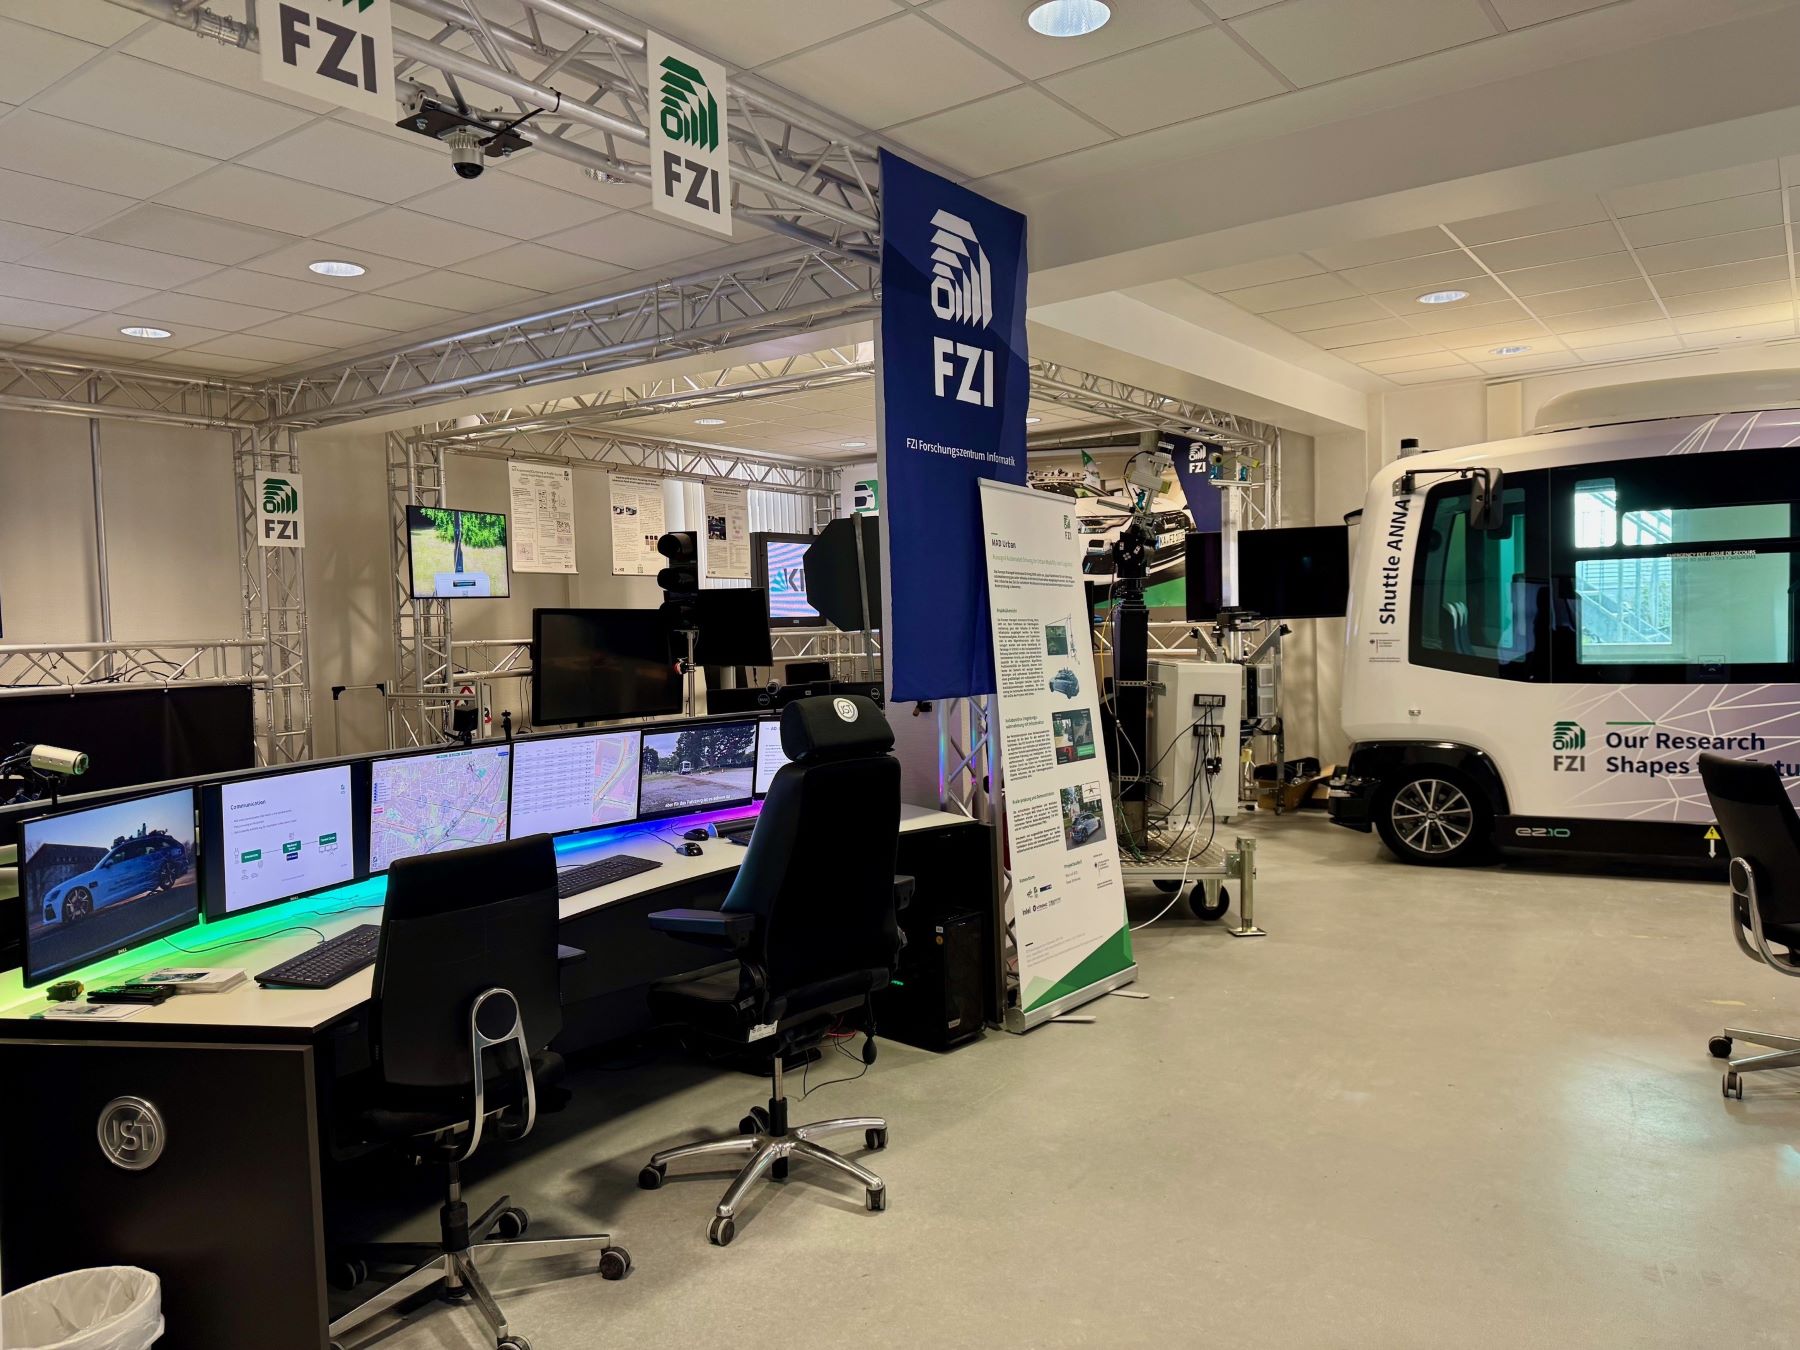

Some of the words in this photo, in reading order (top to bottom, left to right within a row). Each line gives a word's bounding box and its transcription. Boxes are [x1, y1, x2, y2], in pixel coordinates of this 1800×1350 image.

[279, 3, 377, 94] FZI
[663, 150, 721, 215] FZI
[933, 336, 994, 408] FZI
[906, 437, 918, 450] FZI
[919, 439, 986, 461] Forschungszentrum
[986, 452, 1016, 467] Informatik
[1188, 461, 1206, 474] FZI
[264, 519, 298, 540] FZI
[1387, 499, 1411, 551] ANNA
[1379, 556, 1400, 625] Shuttle
[1606, 732, 1648, 749] Our
[1656, 733, 1765, 751] Research
[1553, 755, 1585, 772] FZI
[1606, 756, 1690, 777] Shapes
[230, 800, 266, 810] Communication
